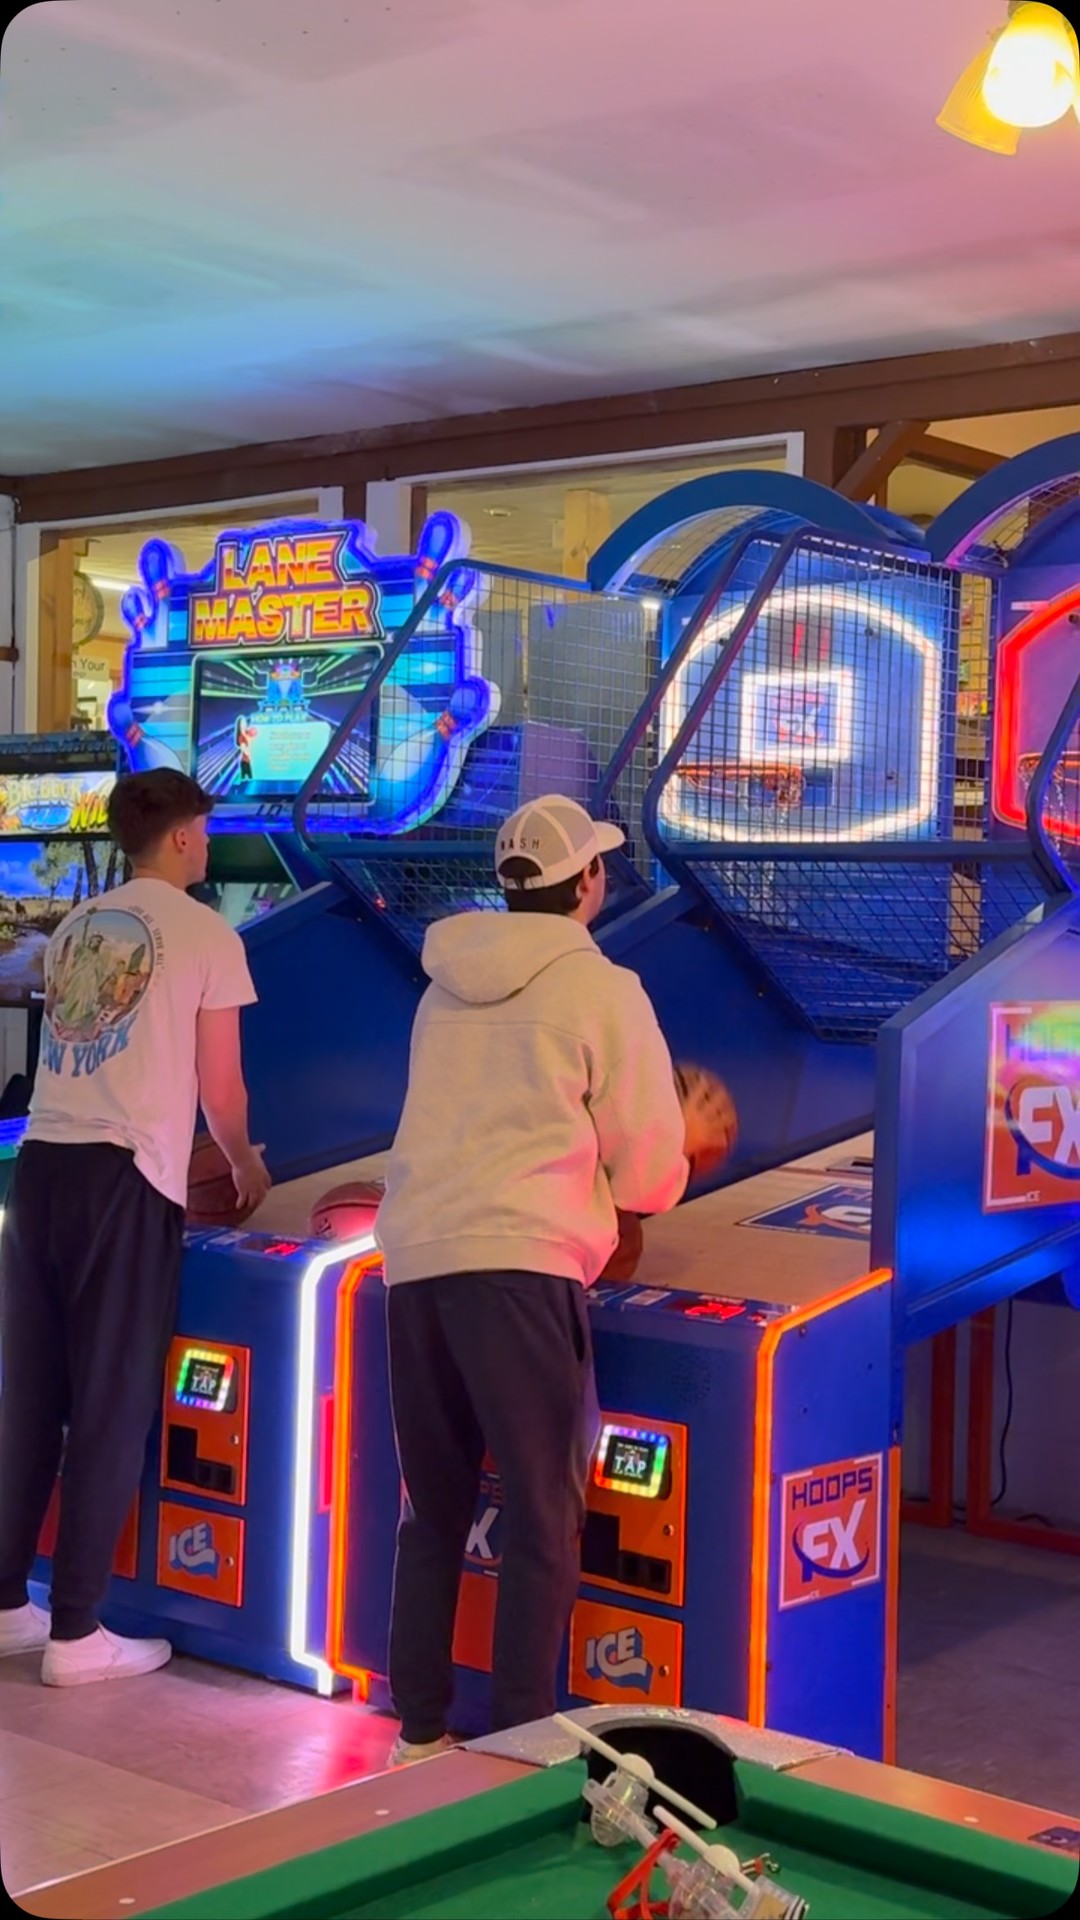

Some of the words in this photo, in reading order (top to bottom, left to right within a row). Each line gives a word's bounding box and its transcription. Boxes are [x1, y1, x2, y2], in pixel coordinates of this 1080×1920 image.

[221, 536, 340, 590] LANE
[193, 587, 372, 642] MASTER
[80, 658, 106, 672] Your
[191, 1374, 217, 1395] TAP
[614, 1454, 648, 1476] TAP
[792, 1466, 873, 1510] HOOPS
[169, 1522, 217, 1570] ICE
[585, 1626, 649, 1680] ICE
